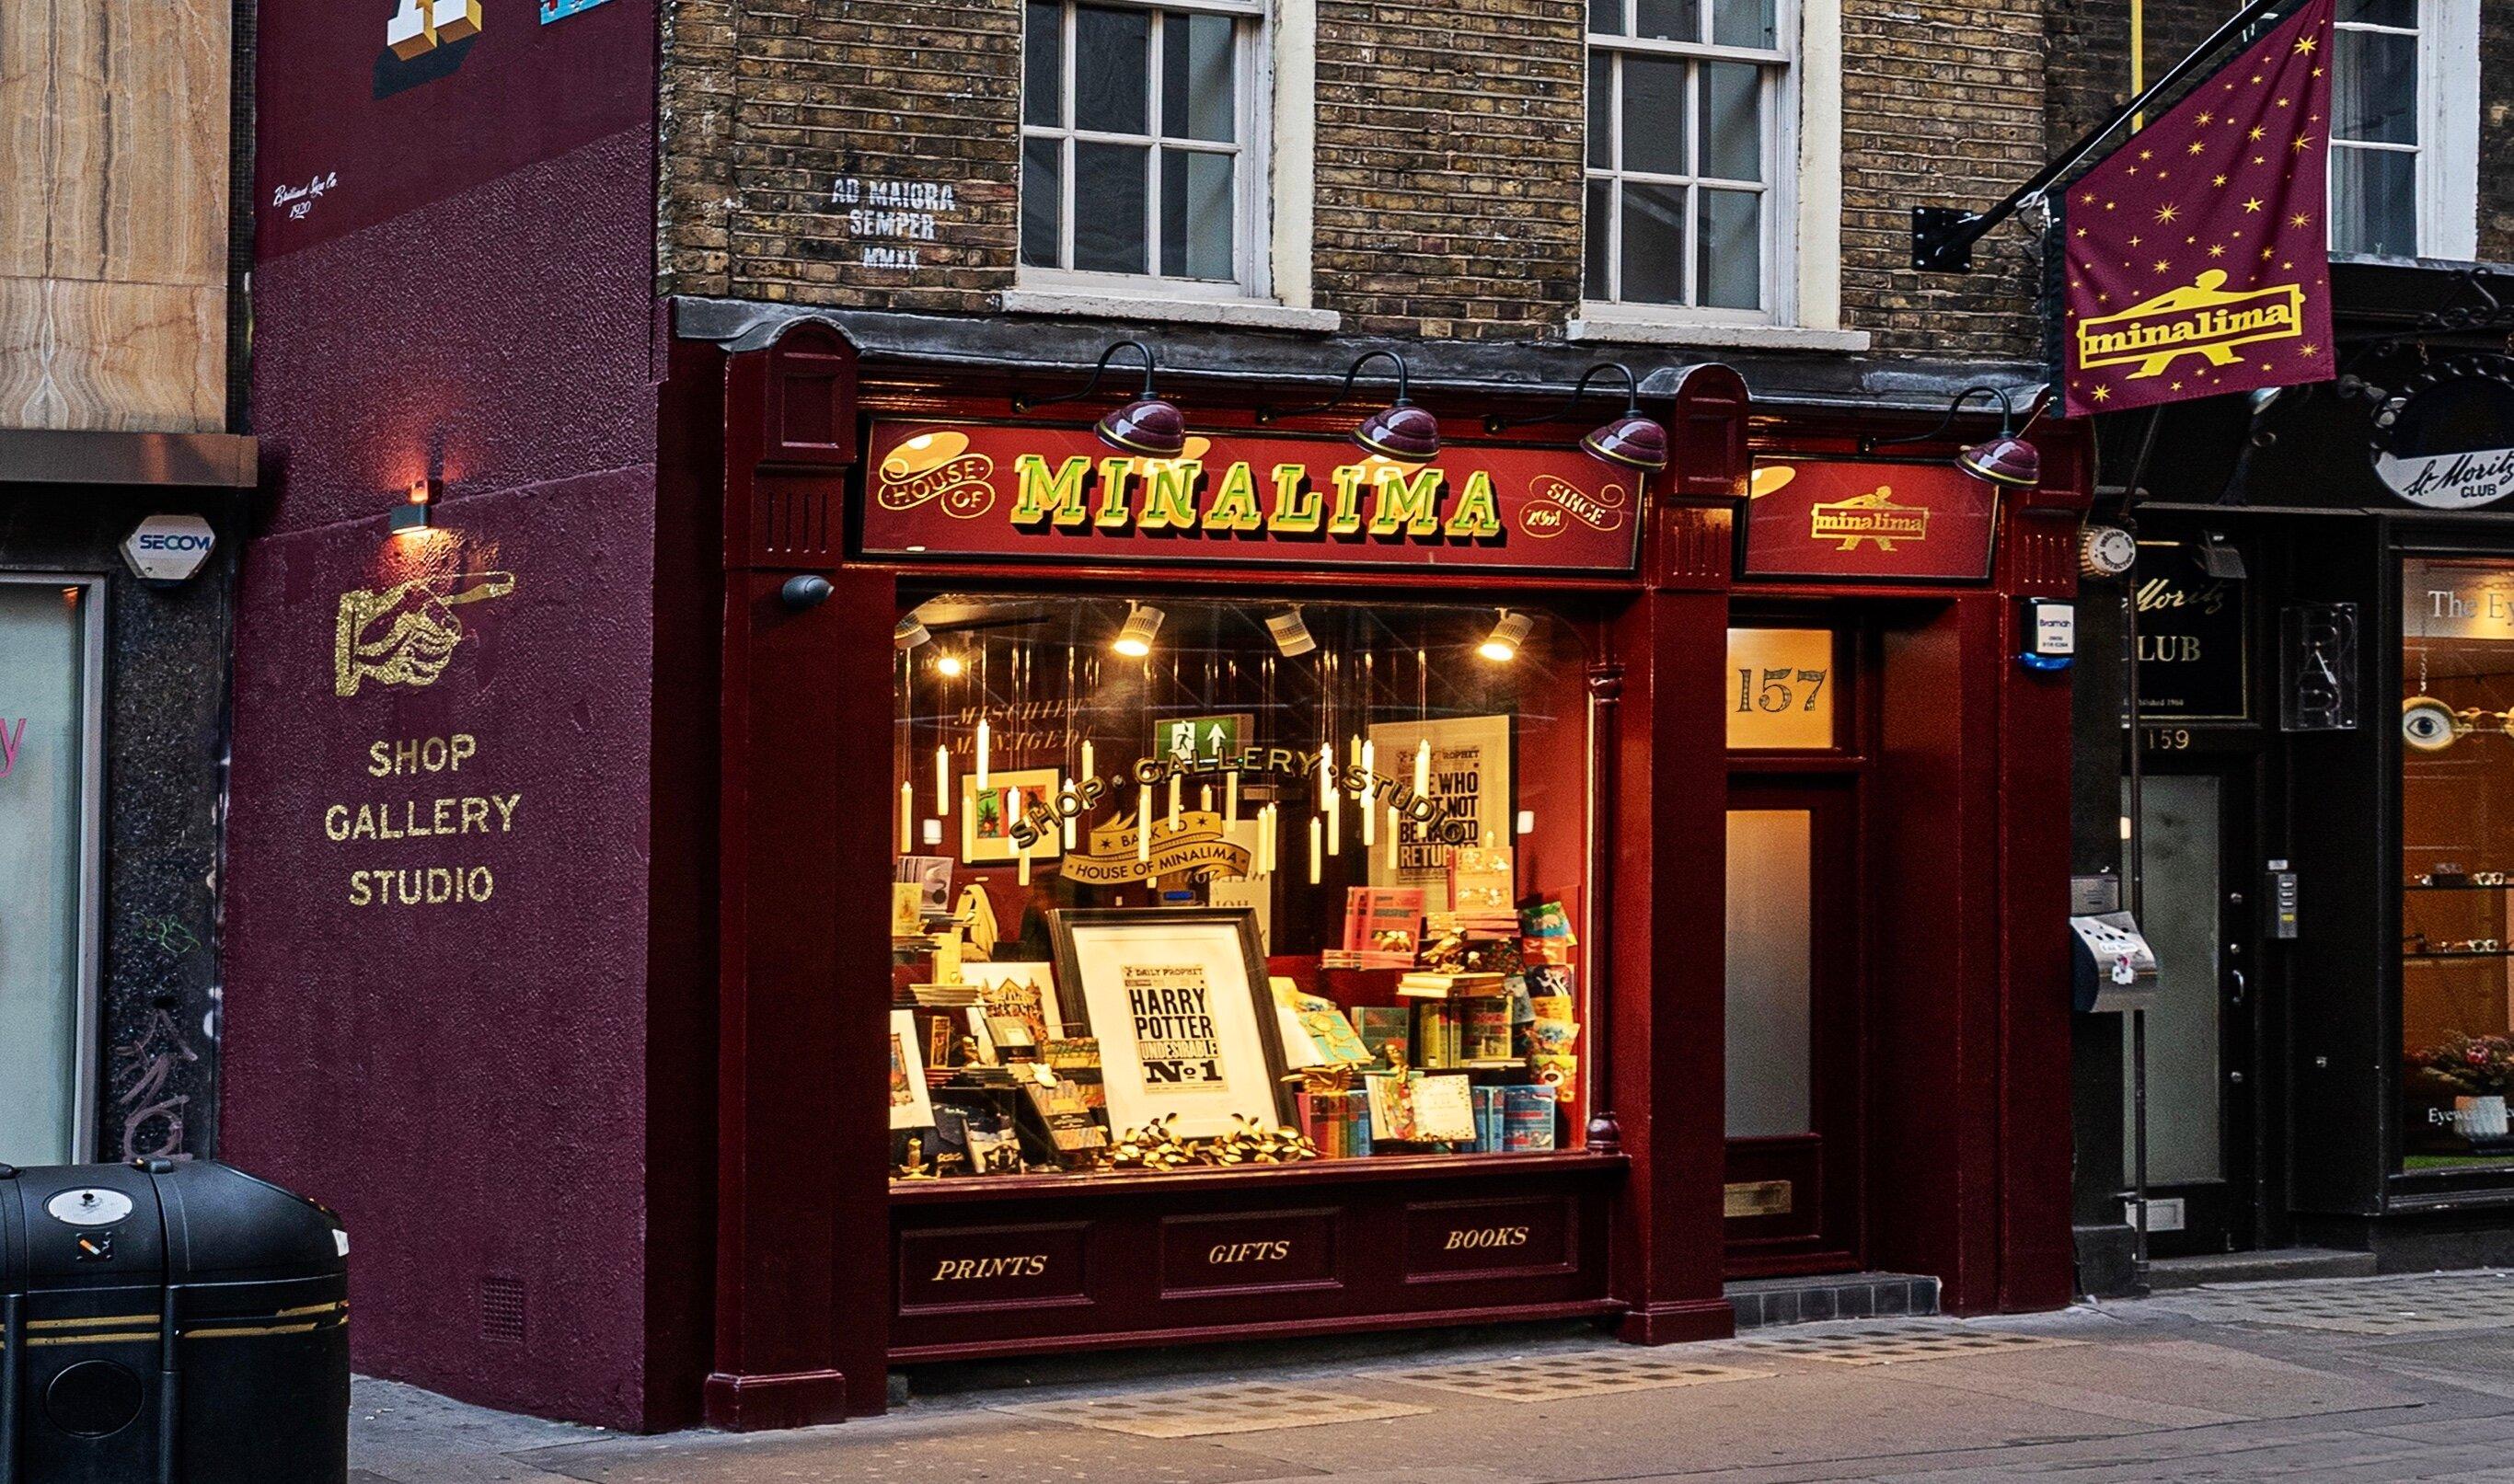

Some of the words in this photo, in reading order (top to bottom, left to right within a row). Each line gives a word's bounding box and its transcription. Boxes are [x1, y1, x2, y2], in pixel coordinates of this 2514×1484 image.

[849, 209, 936, 241] SEMPER
[2084, 303, 2294, 355] minalima
[891, 463, 978, 505] HOUSE
[1009, 454, 1501, 539] MINALIMA
[2460, 483, 2497, 499] CLUB
[951, 489, 985, 510] OF
[1546, 482, 1608, 525] SINCE
[1815, 510, 1924, 532] minalima
[2427, 589, 2479, 619] The
[2121, 635, 2202, 662] LUB
[1736, 666, 1828, 713] 157
[2149, 729, 2190, 750] 159
[368, 733, 478, 777] SHOP
[1009, 775, 1107, 850] SHOP
[1133, 745, 1323, 786] GALLERY
[1342, 764, 1466, 845] STUDIO
[1436, 769, 1479, 796] WHO
[325, 793, 523, 841] GALLERY
[1120, 826, 1162, 847] BAK
[1075, 863, 1129, 880] HOUSE
[1133, 859, 1157, 876] OF
[1159, 846, 1238, 870] MINALIMA
[348, 866, 494, 906] STUDIO
[1128, 986, 1206, 1016] HARRY
[1134, 1015, 1215, 1041] POTTER
[1208, 1240, 1291, 1265] GIFTS
[1443, 1225, 1530, 1250] BOOKS
[930, 1254, 1049, 1282] PRINTS
